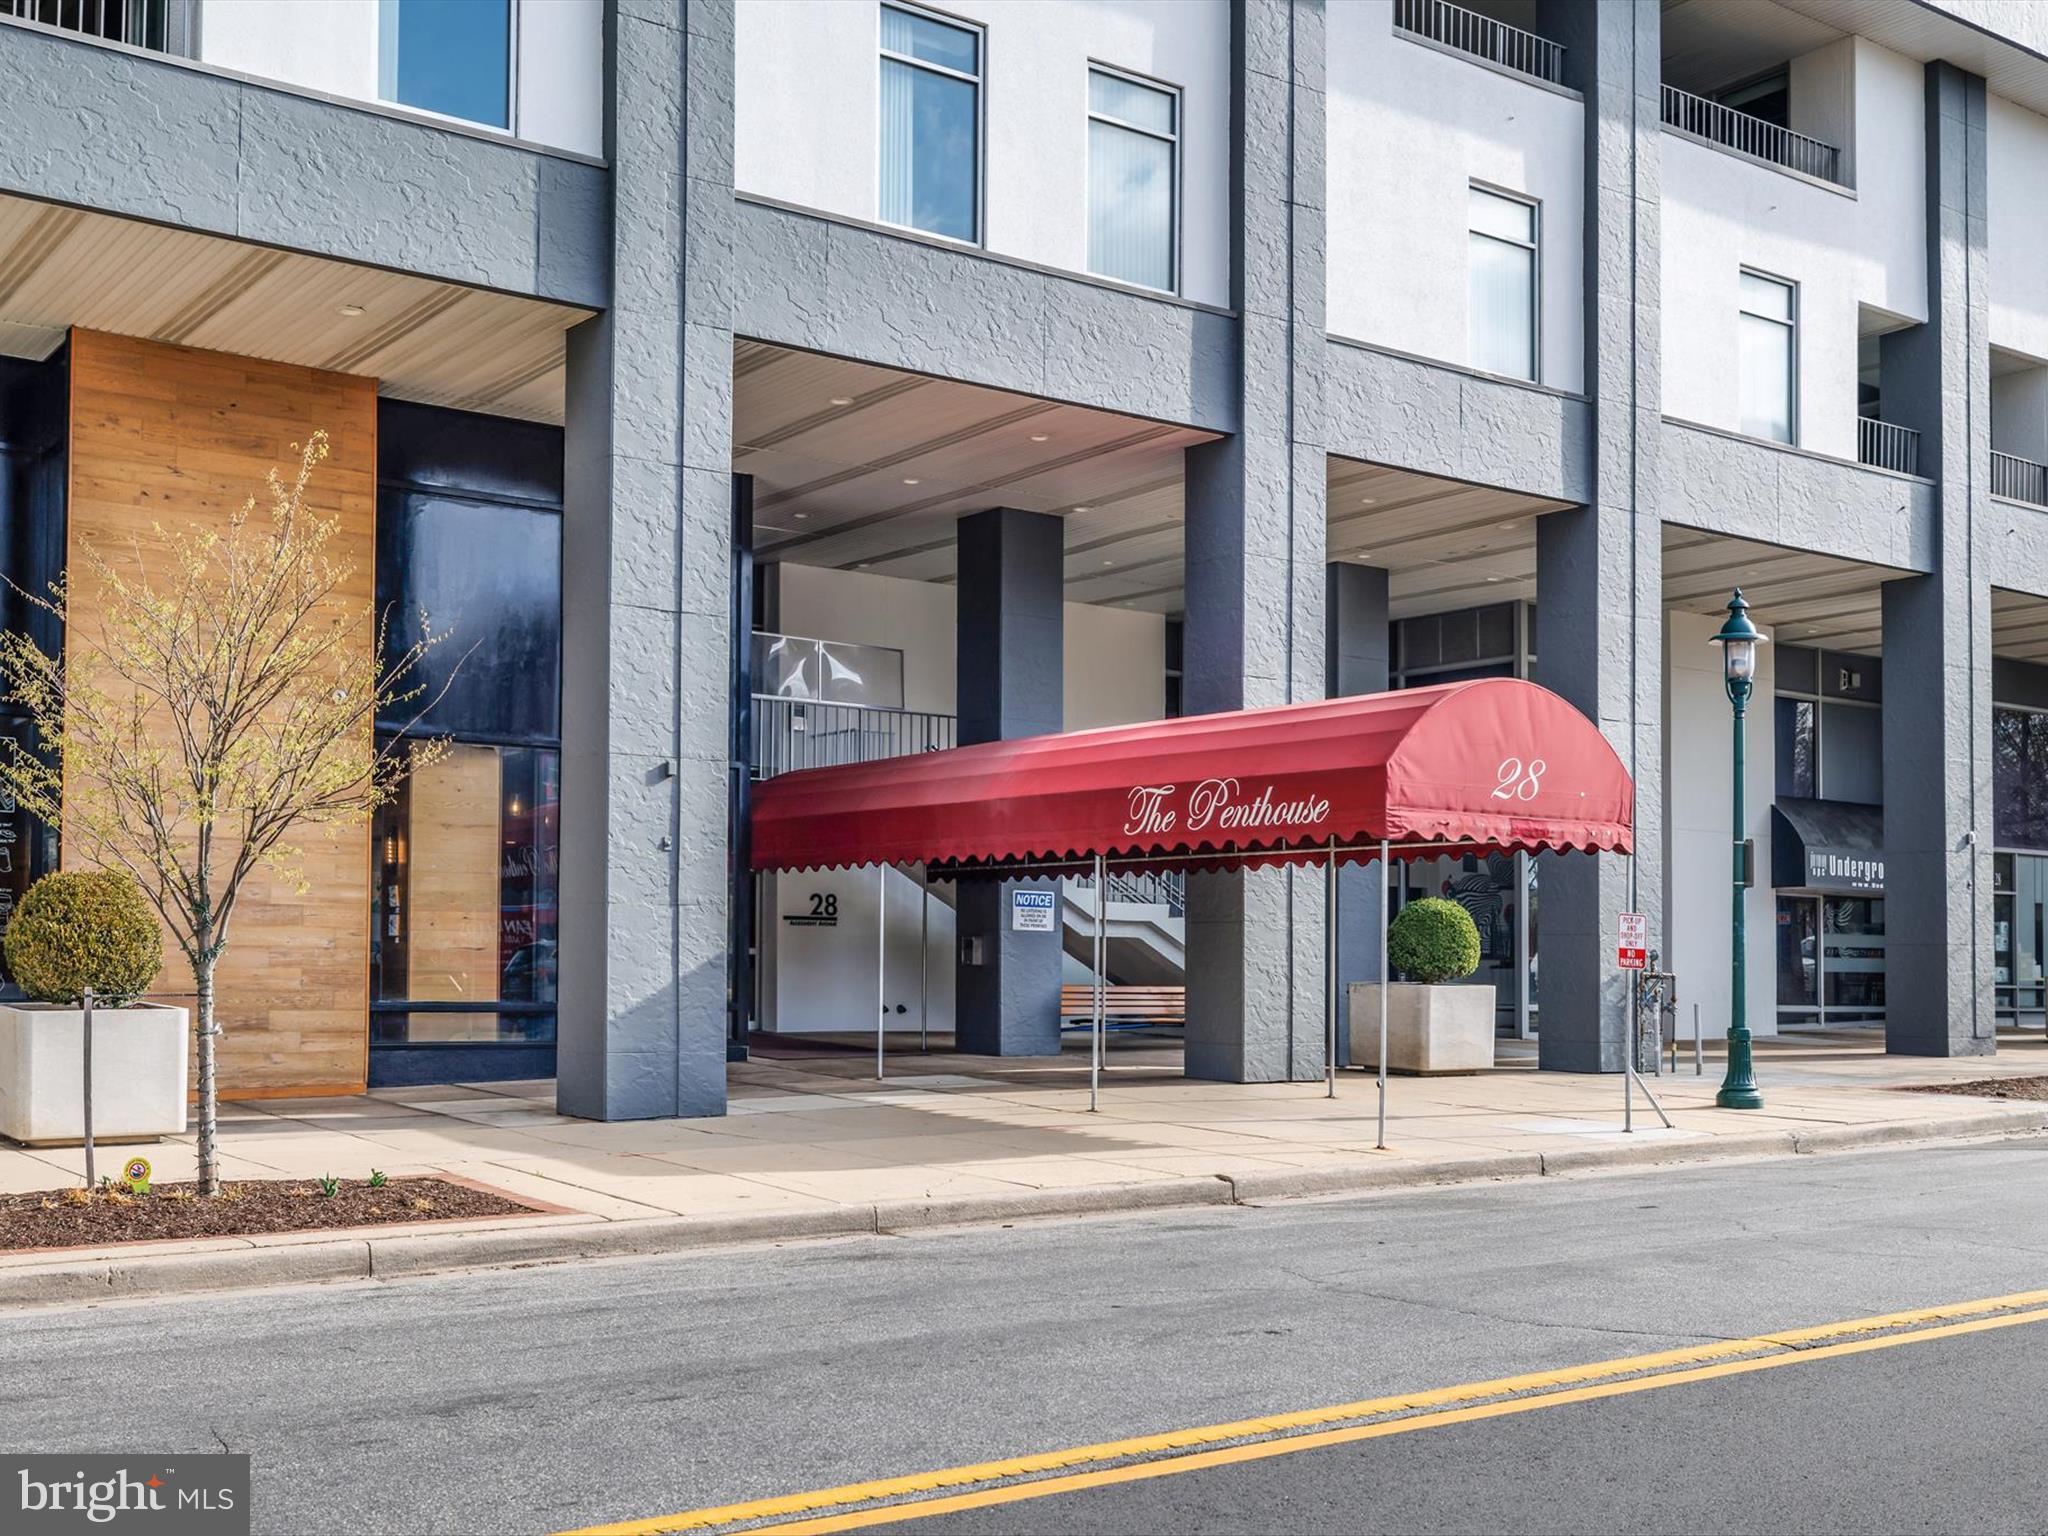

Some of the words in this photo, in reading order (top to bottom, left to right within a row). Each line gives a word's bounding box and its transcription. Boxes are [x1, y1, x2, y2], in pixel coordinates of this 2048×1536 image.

[1490, 757, 1546, 801] 28
[1123, 784, 1176, 836] The
[1187, 778, 1330, 831] Penthouse
[810, 893, 838, 916] 28
[1015, 894, 1052, 906] NOTICE
[1626, 949, 1636, 958] NO
[1620, 958, 1645, 968] PARKING
